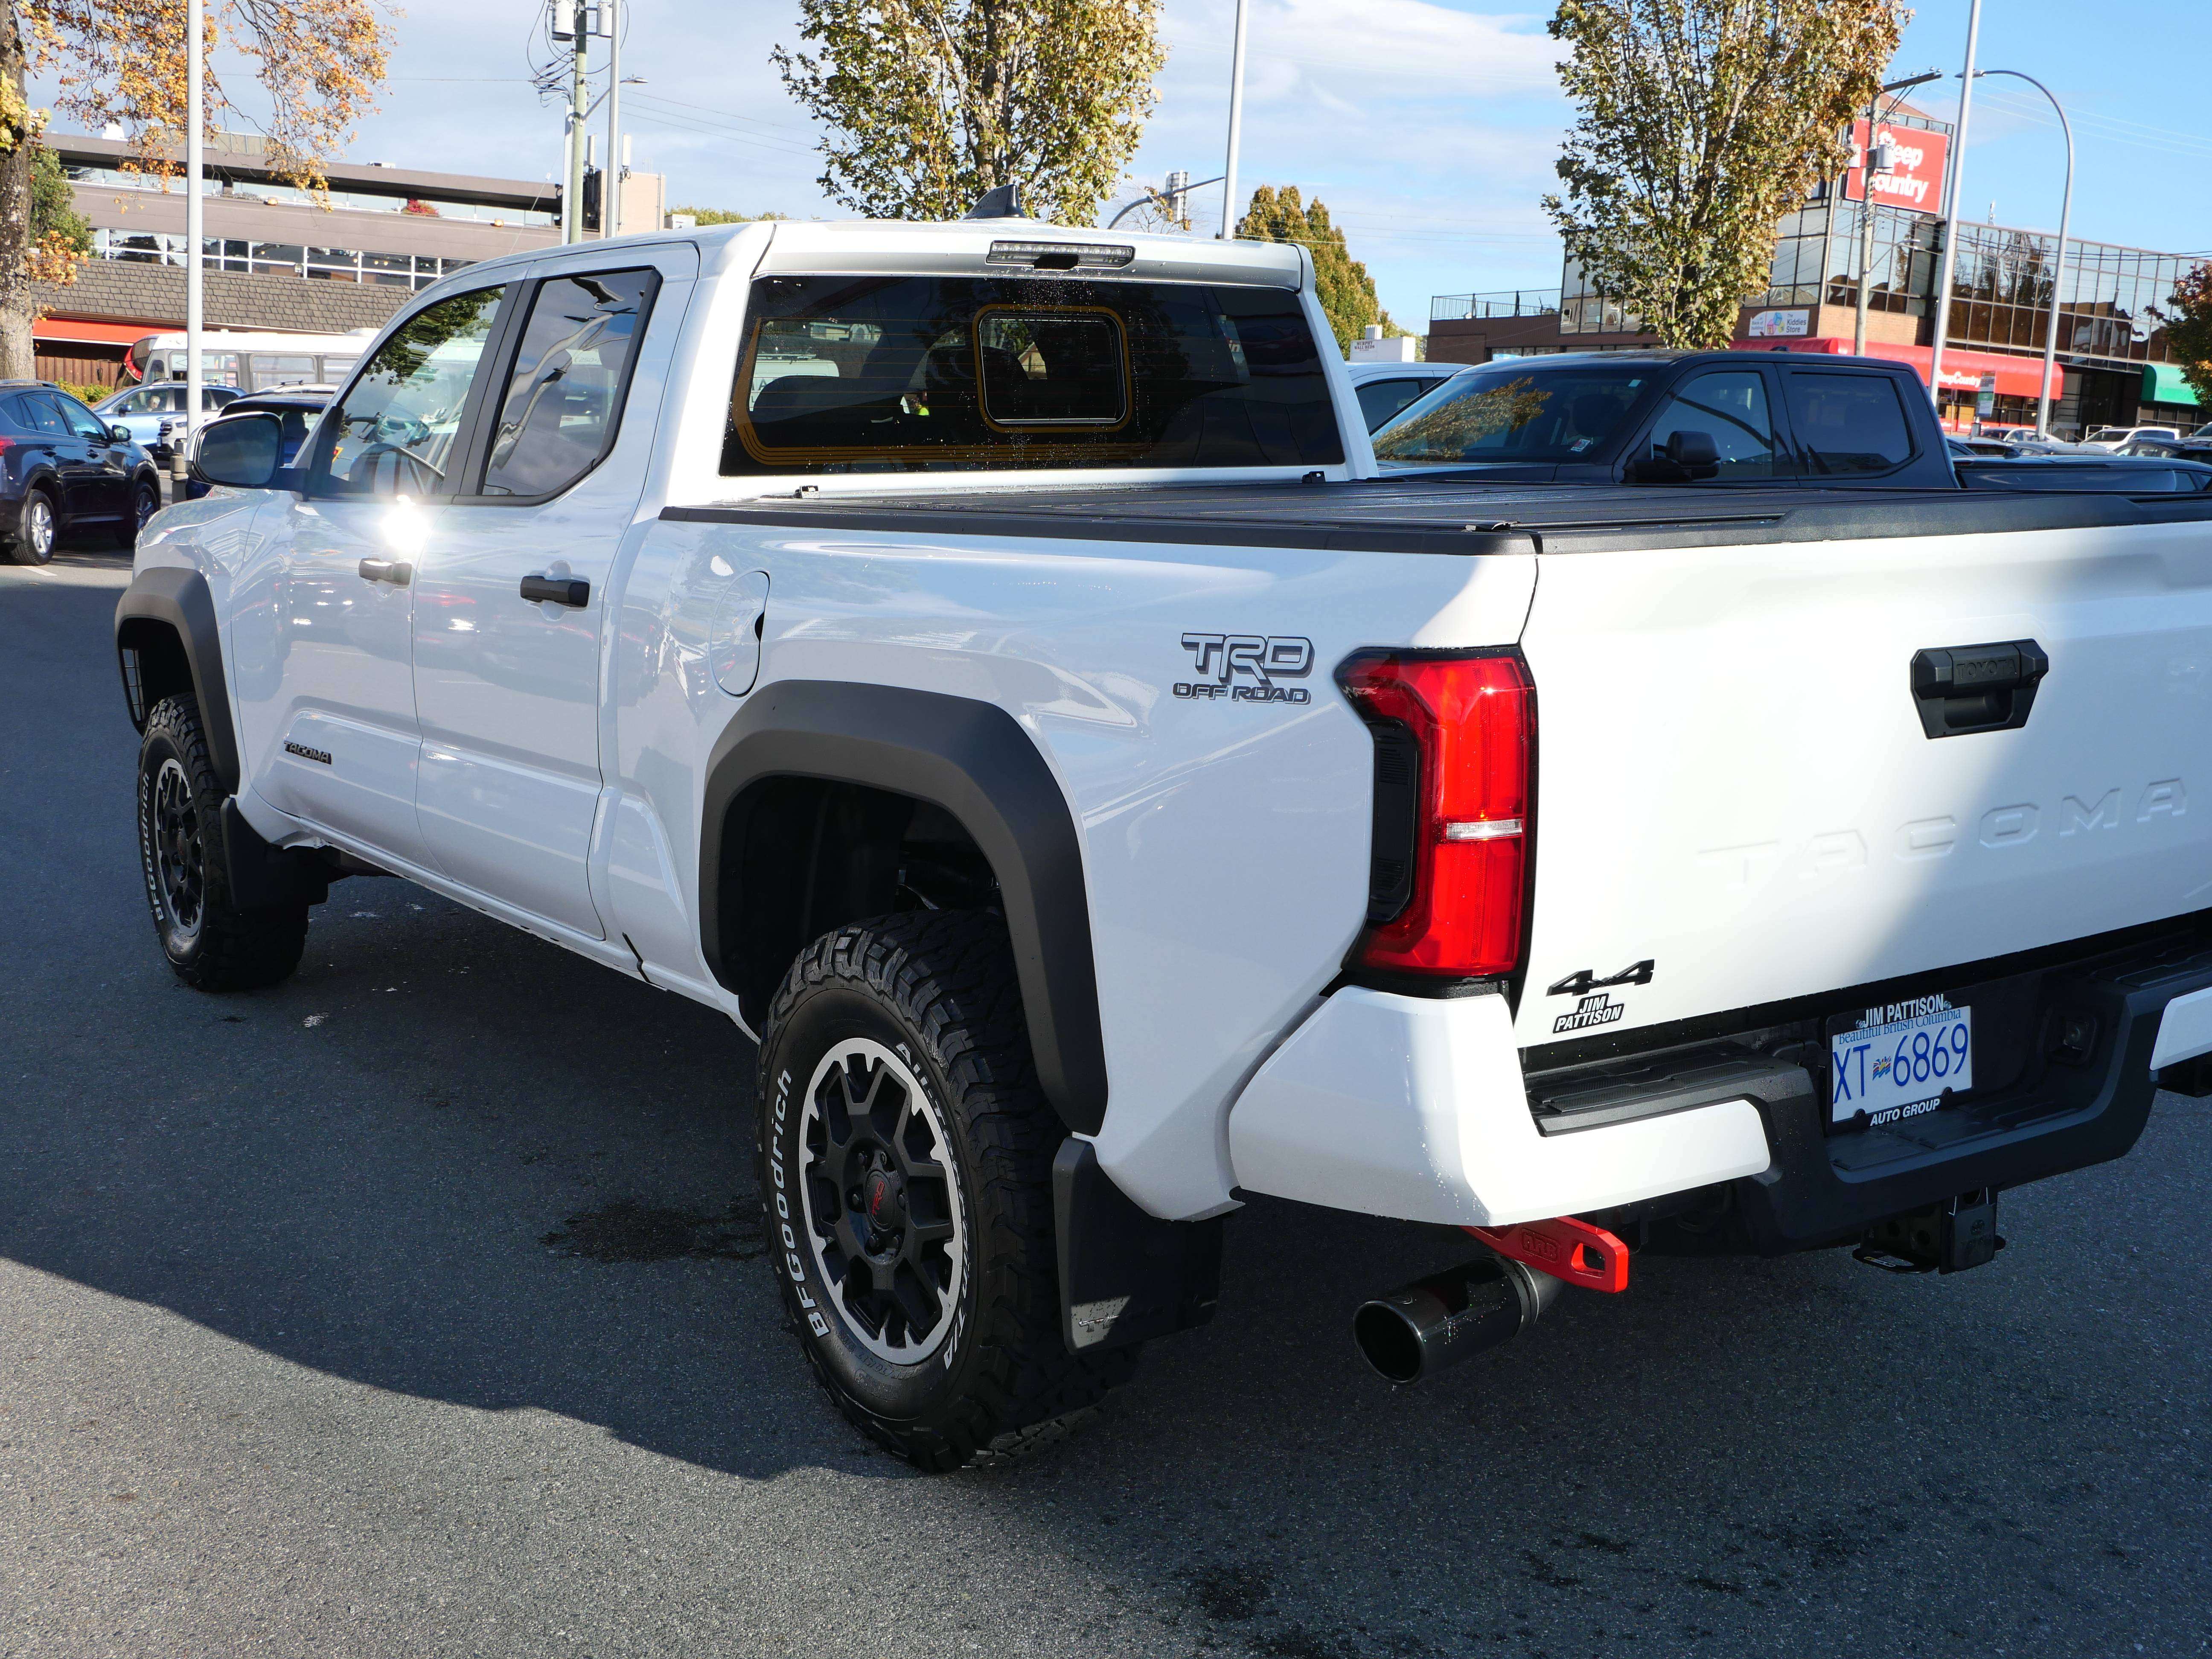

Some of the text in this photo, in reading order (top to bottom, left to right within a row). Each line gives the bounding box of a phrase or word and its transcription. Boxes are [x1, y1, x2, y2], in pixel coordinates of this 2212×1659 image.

[1181, 632, 1315, 688] TRD
[1956, 659, 2018, 679] TOYOTA
[1173, 682, 1311, 705] OFF ROAD
[283, 740, 332, 765] TACOMA
[1697, 777, 2188, 890] TACOMA
[1555, 1005, 1622, 1032] PATTISON
[1579, 995, 1606, 1014] JIM
[1864, 993, 1944, 1028] JIM PATTISON
[1838, 1008, 1961, 1045] Beautiful British Columbia
[1833, 1023, 1969, 1103] XT 6869
[1870, 1098, 1941, 1127] AUTO GROUP
[771, 1068, 830, 1337] BFGoodrich
